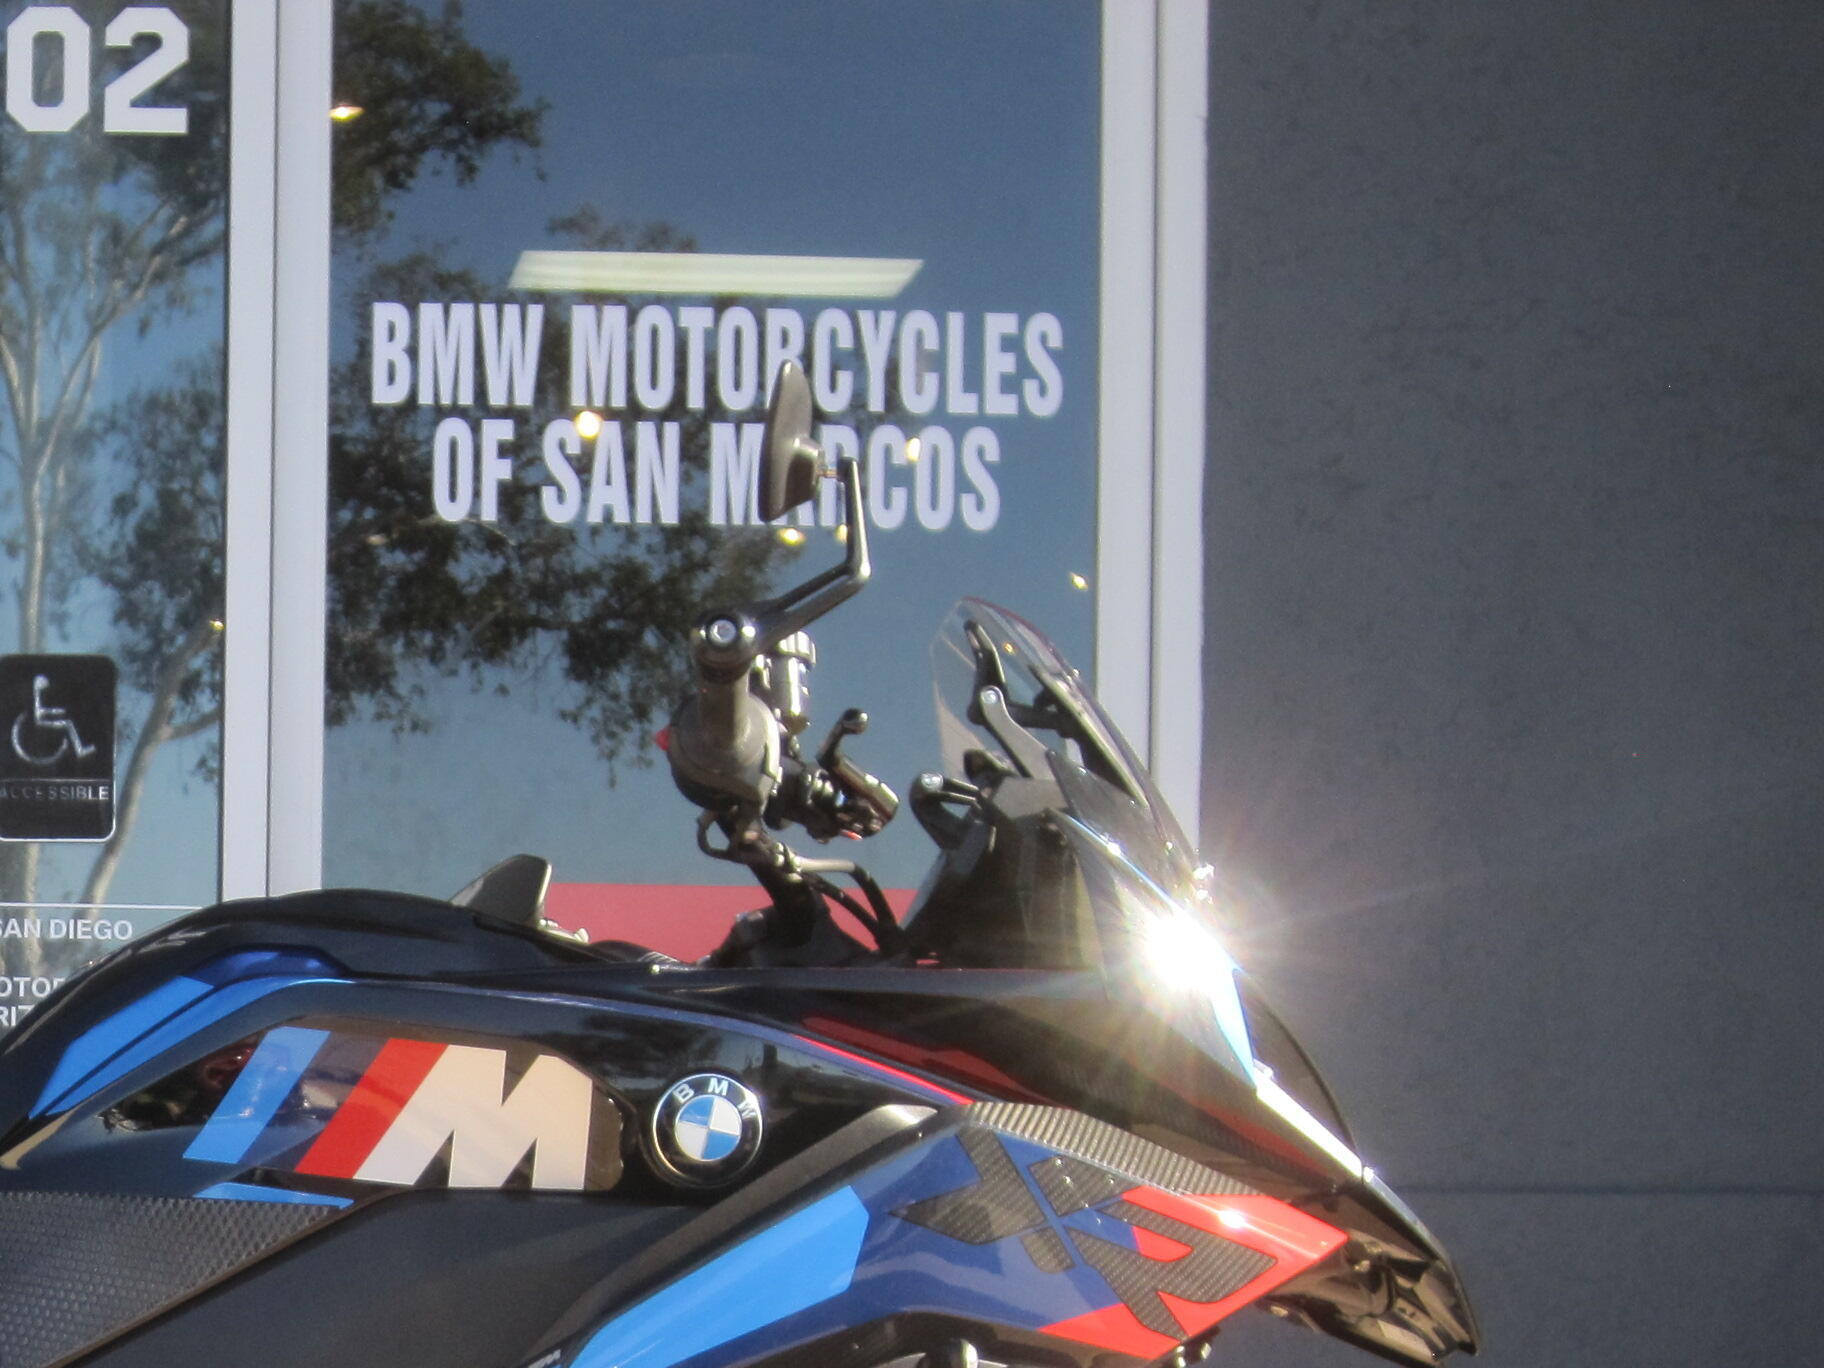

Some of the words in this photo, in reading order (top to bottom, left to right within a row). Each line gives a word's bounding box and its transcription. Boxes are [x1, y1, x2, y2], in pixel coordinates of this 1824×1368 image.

[371, 301, 544, 408] BMW
[570, 305, 1063, 417] MOTORCYCLES
[432, 418, 513, 524] OF
[541, 421, 680, 526] SAN
[709, 422, 1001, 532] MRCOS
[49, 919, 133, 940] DIEGO
[354, 1044, 592, 1190] M
[672, 1077, 757, 1119] BMW
